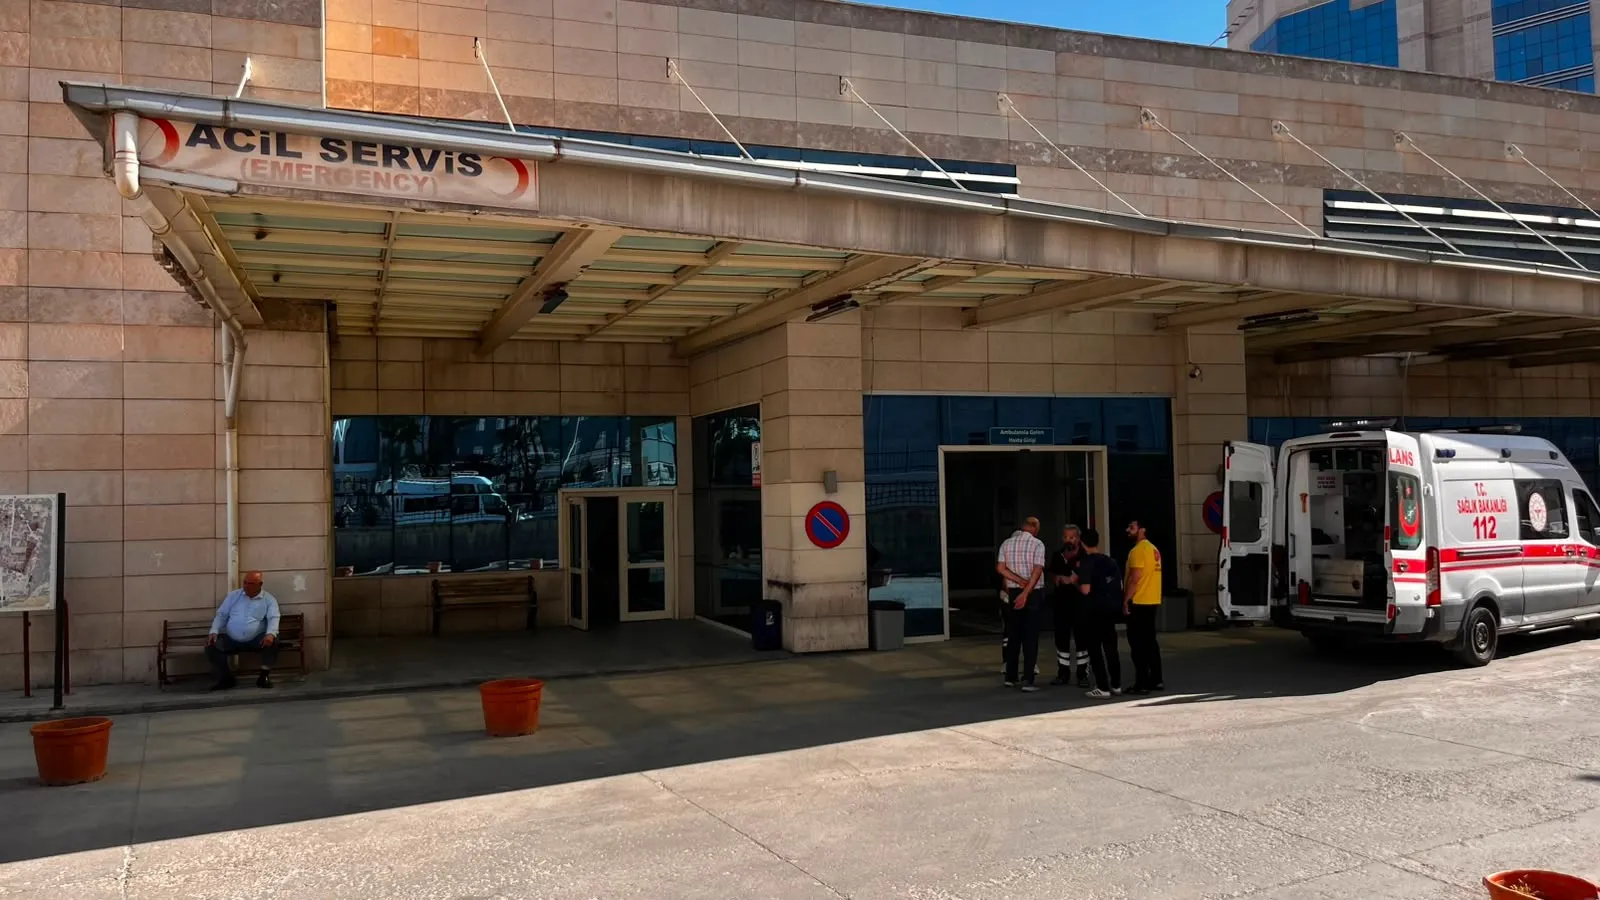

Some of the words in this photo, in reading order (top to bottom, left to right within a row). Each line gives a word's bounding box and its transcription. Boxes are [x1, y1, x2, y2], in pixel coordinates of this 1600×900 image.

[240, 158, 438, 196] (EMERGENCY)
[1457, 497, 1478, 514] SAĞLIK
[1473, 516, 1497, 540] 112
